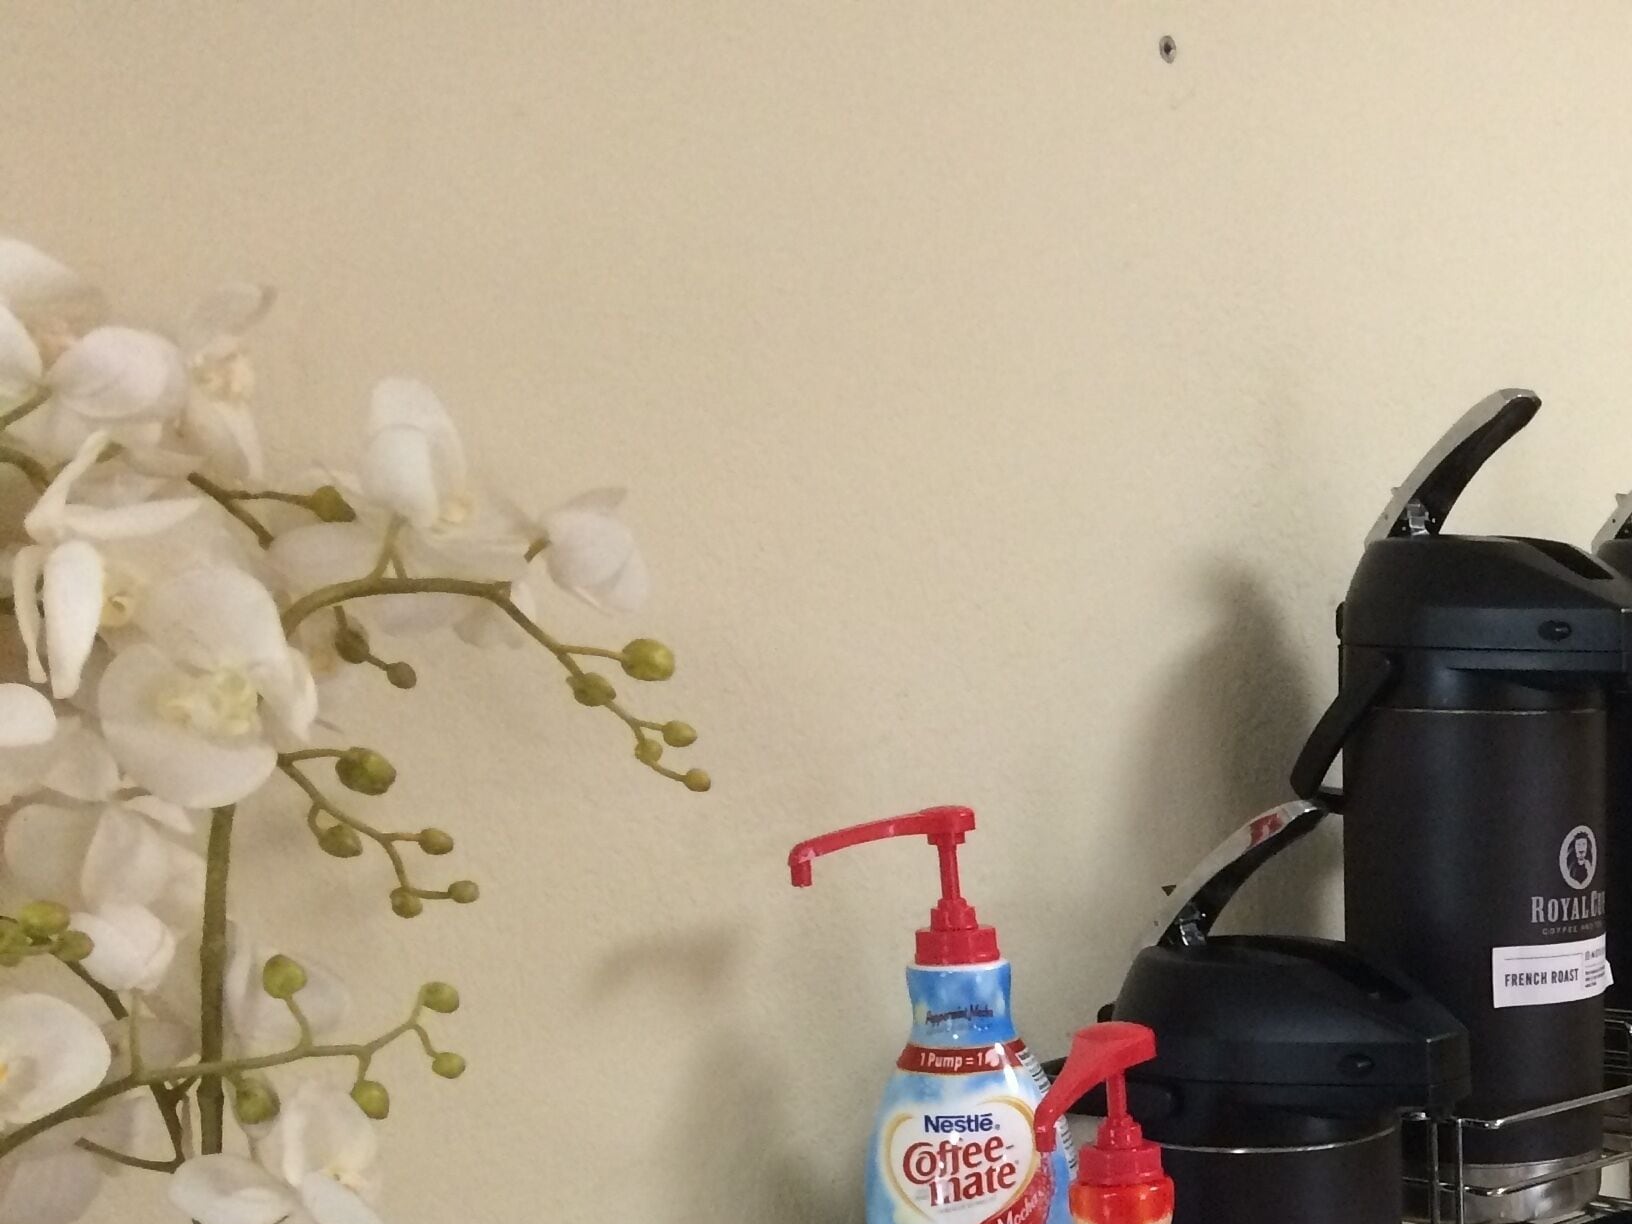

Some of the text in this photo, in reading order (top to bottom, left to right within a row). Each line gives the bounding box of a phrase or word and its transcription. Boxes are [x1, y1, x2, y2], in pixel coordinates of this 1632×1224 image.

[1542, 926, 1578, 935] COFFEE
[1505, 972, 1548, 987] FRENCH
[1551, 968, 1579, 984] ROAST
[920, 1053, 925, 1066] 1
[927, 1052, 962, 1071] Pump
[924, 1113, 994, 1133] Nestlé
[929, 1162, 1017, 1207] mate
